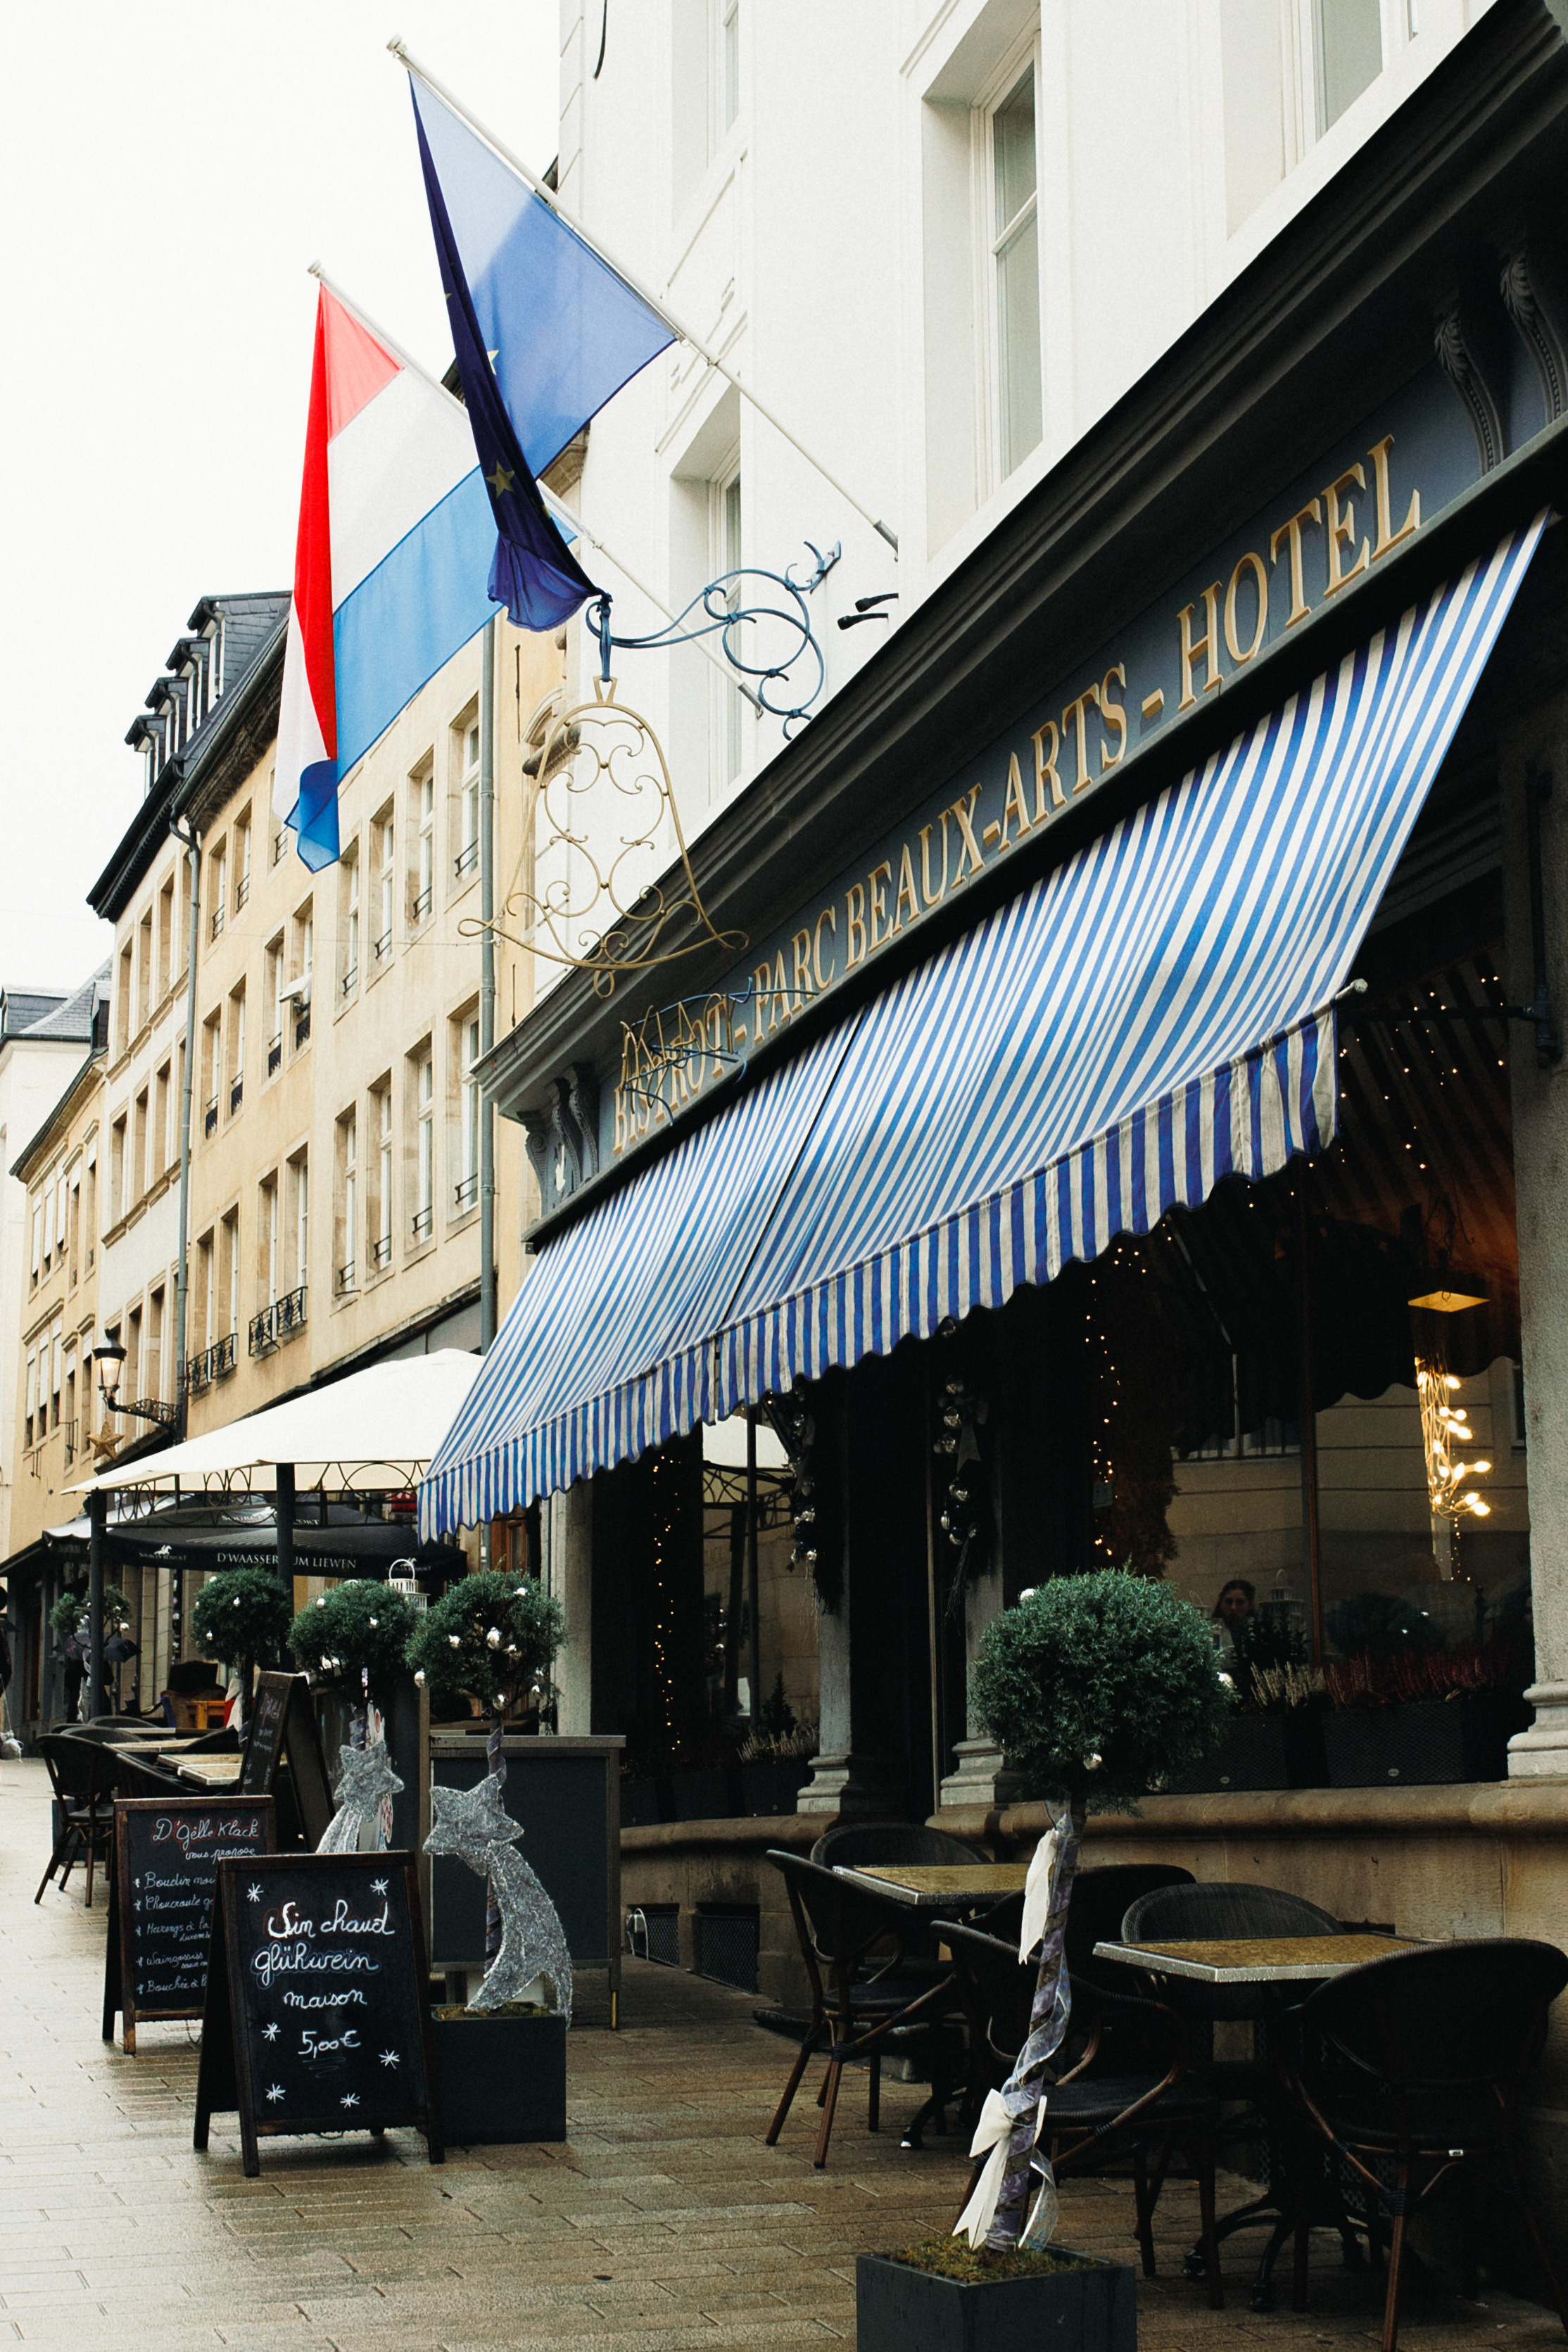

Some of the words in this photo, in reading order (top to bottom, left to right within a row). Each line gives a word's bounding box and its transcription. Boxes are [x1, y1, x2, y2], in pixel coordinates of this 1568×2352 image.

[612, 999, 726, 1156] BISTROT
[754, 905, 836, 1044] PARC
[845, 662, 1127, 972] BEAUX-ARTS
[1176, 434, 1421, 712] HOTEL
[217, 1553, 279, 1564] D'WAASSER
[313, 1557, 357, 1569] LIEWEN
[217, 1819, 259, 1838] Klack
[144, 1871, 191, 1890] Boudin
[320, 1899, 396, 1935] chaud
[283, 1989, 368, 2009] maison
